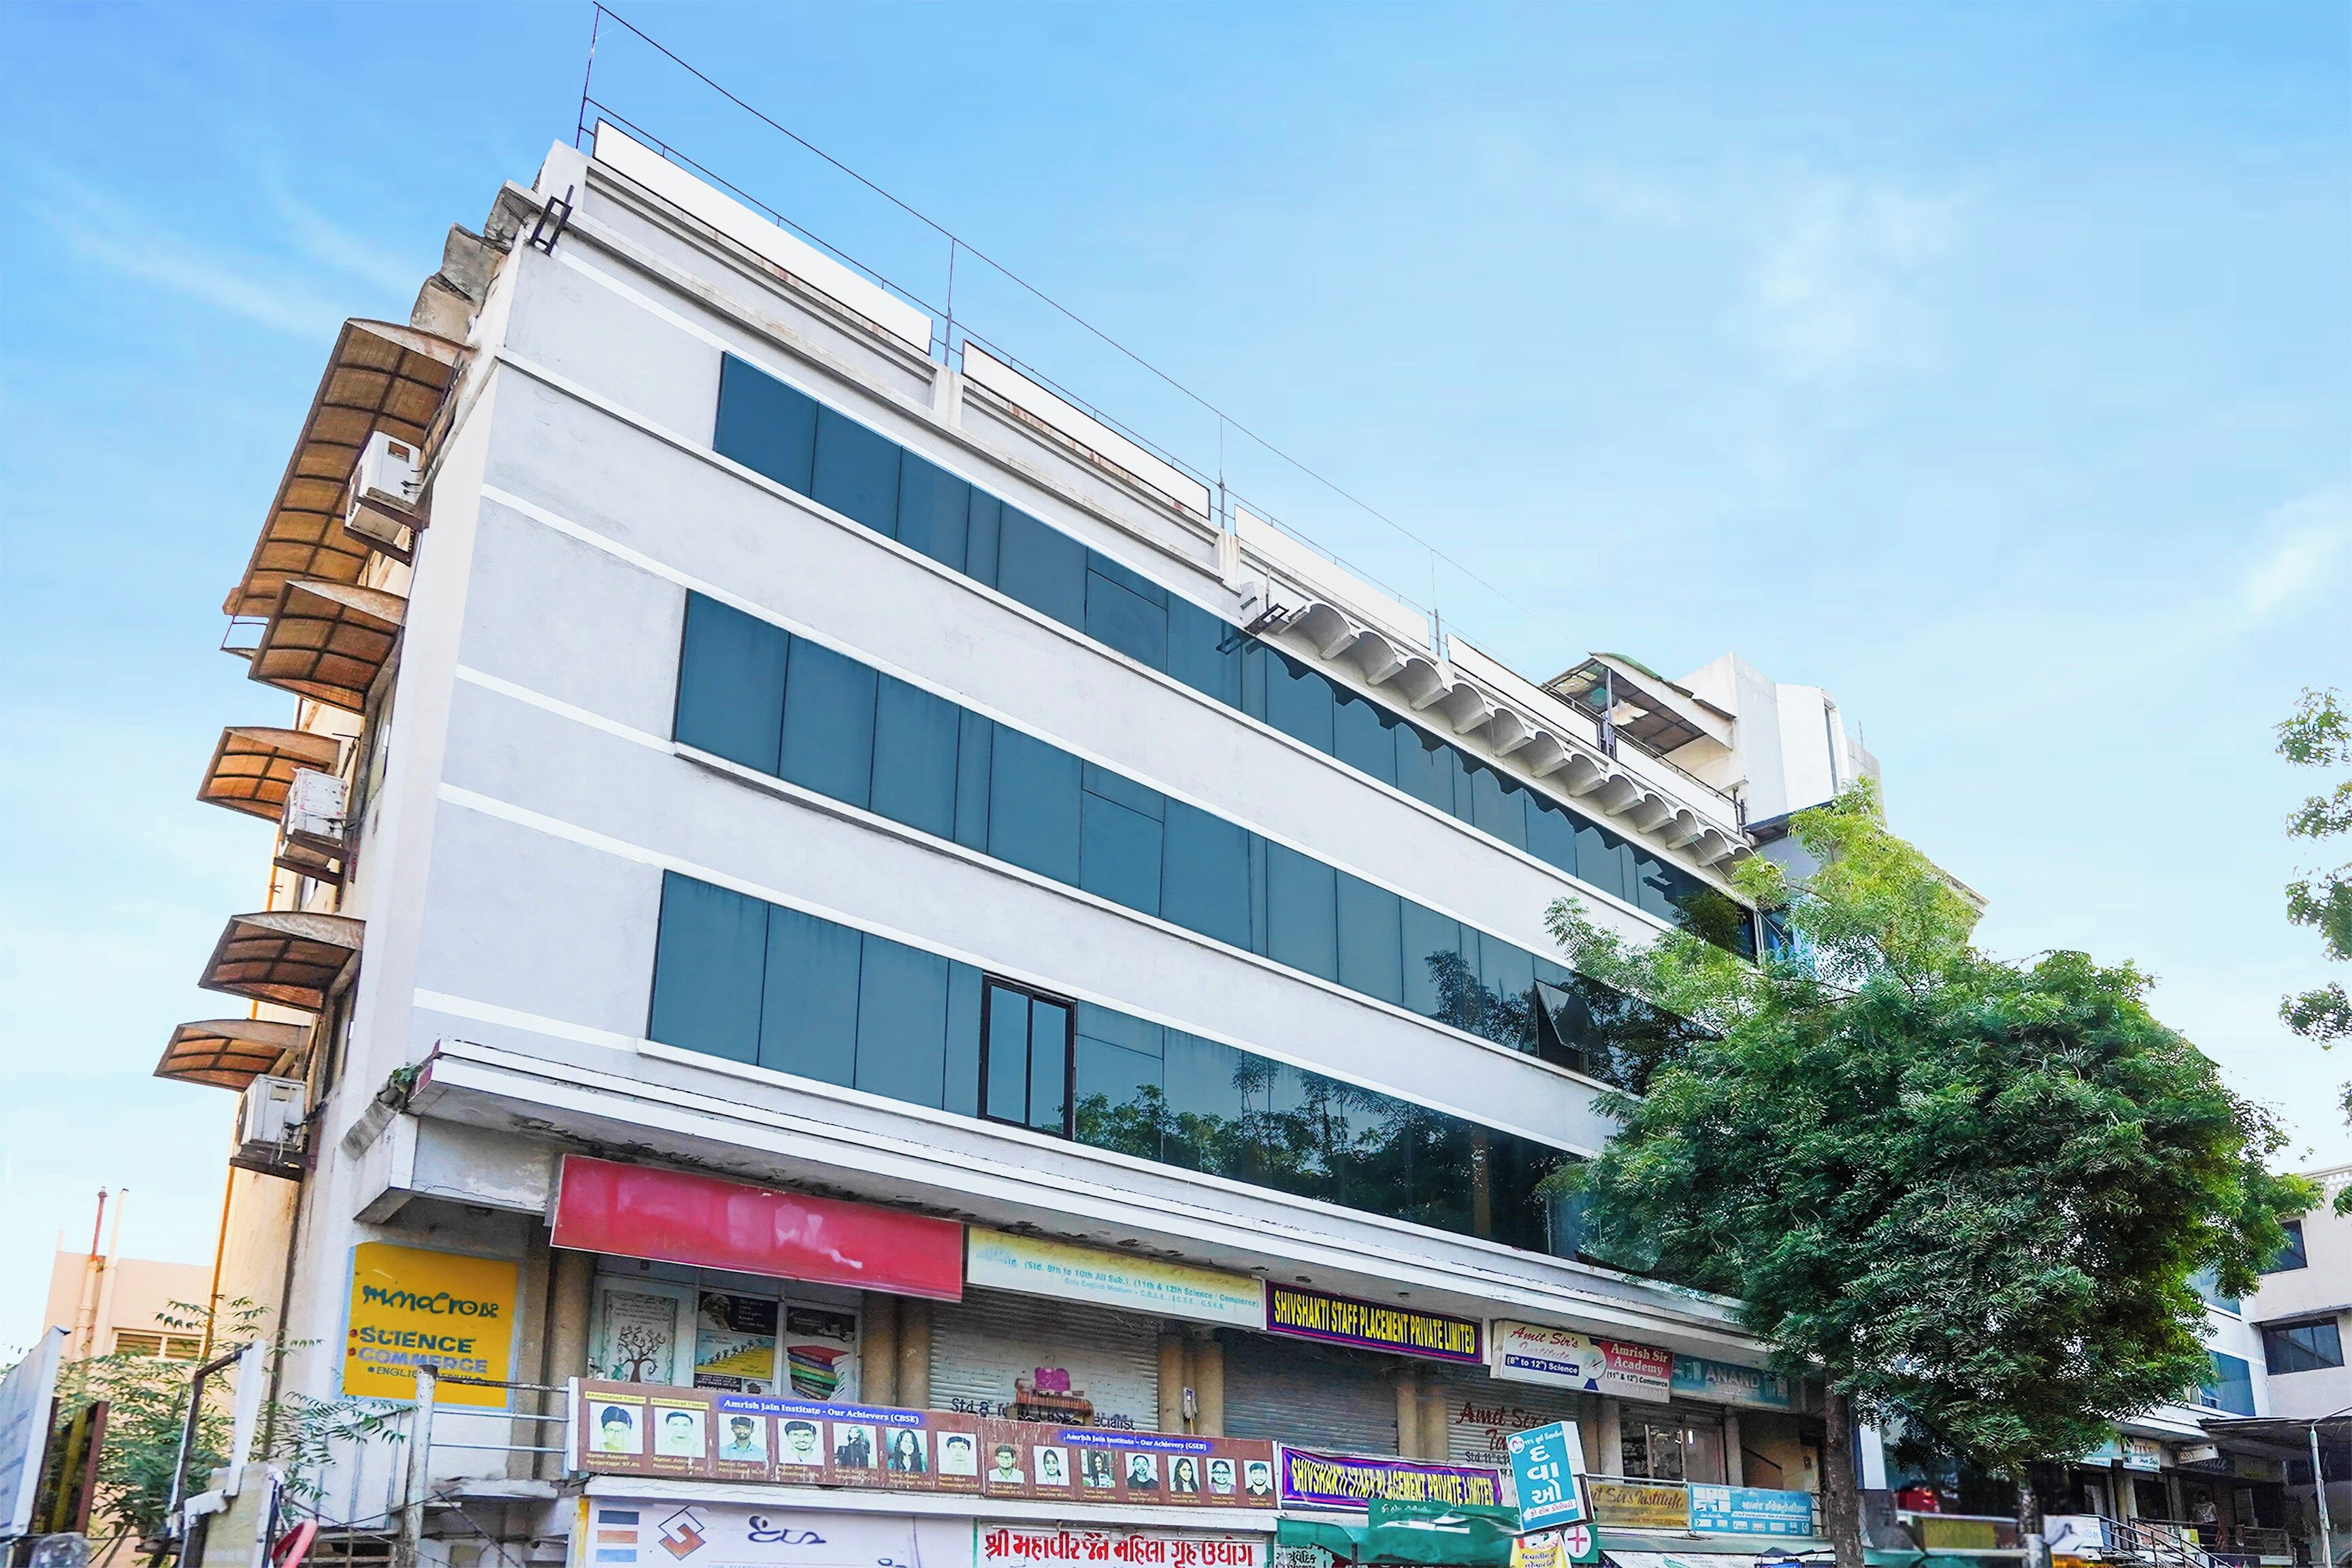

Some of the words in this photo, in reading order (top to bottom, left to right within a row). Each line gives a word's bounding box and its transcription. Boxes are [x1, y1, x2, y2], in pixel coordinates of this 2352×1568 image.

[1076, 1269, 1093, 1278] 10th
[1095, 1272, 1106, 1281] All
[1134, 1279, 1154, 1290] (11th
[1166, 1284, 1182, 1294] 12th
[1184, 1288, 1213, 1299] Science
[1220, 1294, 1259, 1307] Commerce)
[1274, 1290, 1330, 1331] SHIVSHAKTI
[1330, 1301, 1358, 1335] STAFF
[1359, 1305, 1409, 1343] PLACEMENT
[1409, 1315, 1443, 1349] PRIVATE
[1444, 1320, 1475, 1354] LIMITED
[359, 1326, 476, 1354] SCIENCE
[1509, 1326, 1546, 1343] Amit
[1550, 1333, 1580, 1349] Sir's
[358, 1347, 488, 1373] COMMERCE
[1611, 1342, 1651, 1360] Amrish
[1652, 1350, 1669, 1363] Sir
[1520, 1358, 1529, 1367] to
[1548, 1362, 1578, 1374] Science
[1614, 1356, 1664, 1376] Academy
[1620, 1372, 1625, 1381] &
[1705, 1365, 1761, 1389] ANAND
[723, 1399, 760, 1410] Amrish
[761, 1402, 780, 1412] Jain
[781, 1405, 821, 1416] Institute
[828, 1409, 845, 1417] Our
[846, 1409, 889, 1421] Achievers
[890, 1414, 919, 1424] (CBSE)
[1456, 1401, 1506, 1426] Amit
[1066, 1433, 1091, 1441] Amrish
[1107, 1437, 1134, 1445] Institute
[1154, 1440, 1184, 1449] Achievers
[1185, 1442, 1207, 1451] (GSEB)
[1291, 1457, 1349, 1496] SHIVSHAKTI
[1426, 1473, 1463, 1507] PRIVATE
[1463, 1475, 1494, 1507] LIMITED
[985, 1529, 1009, 1561] શ્રી
[1012, 1531, 1081, 1561] મહાવીર
[1081, 1532, 1109, 1561] જૈન
[1113, 1535, 1165, 1563] મહિલા
[1171, 1539, 1197, 1568] ગૃહ
